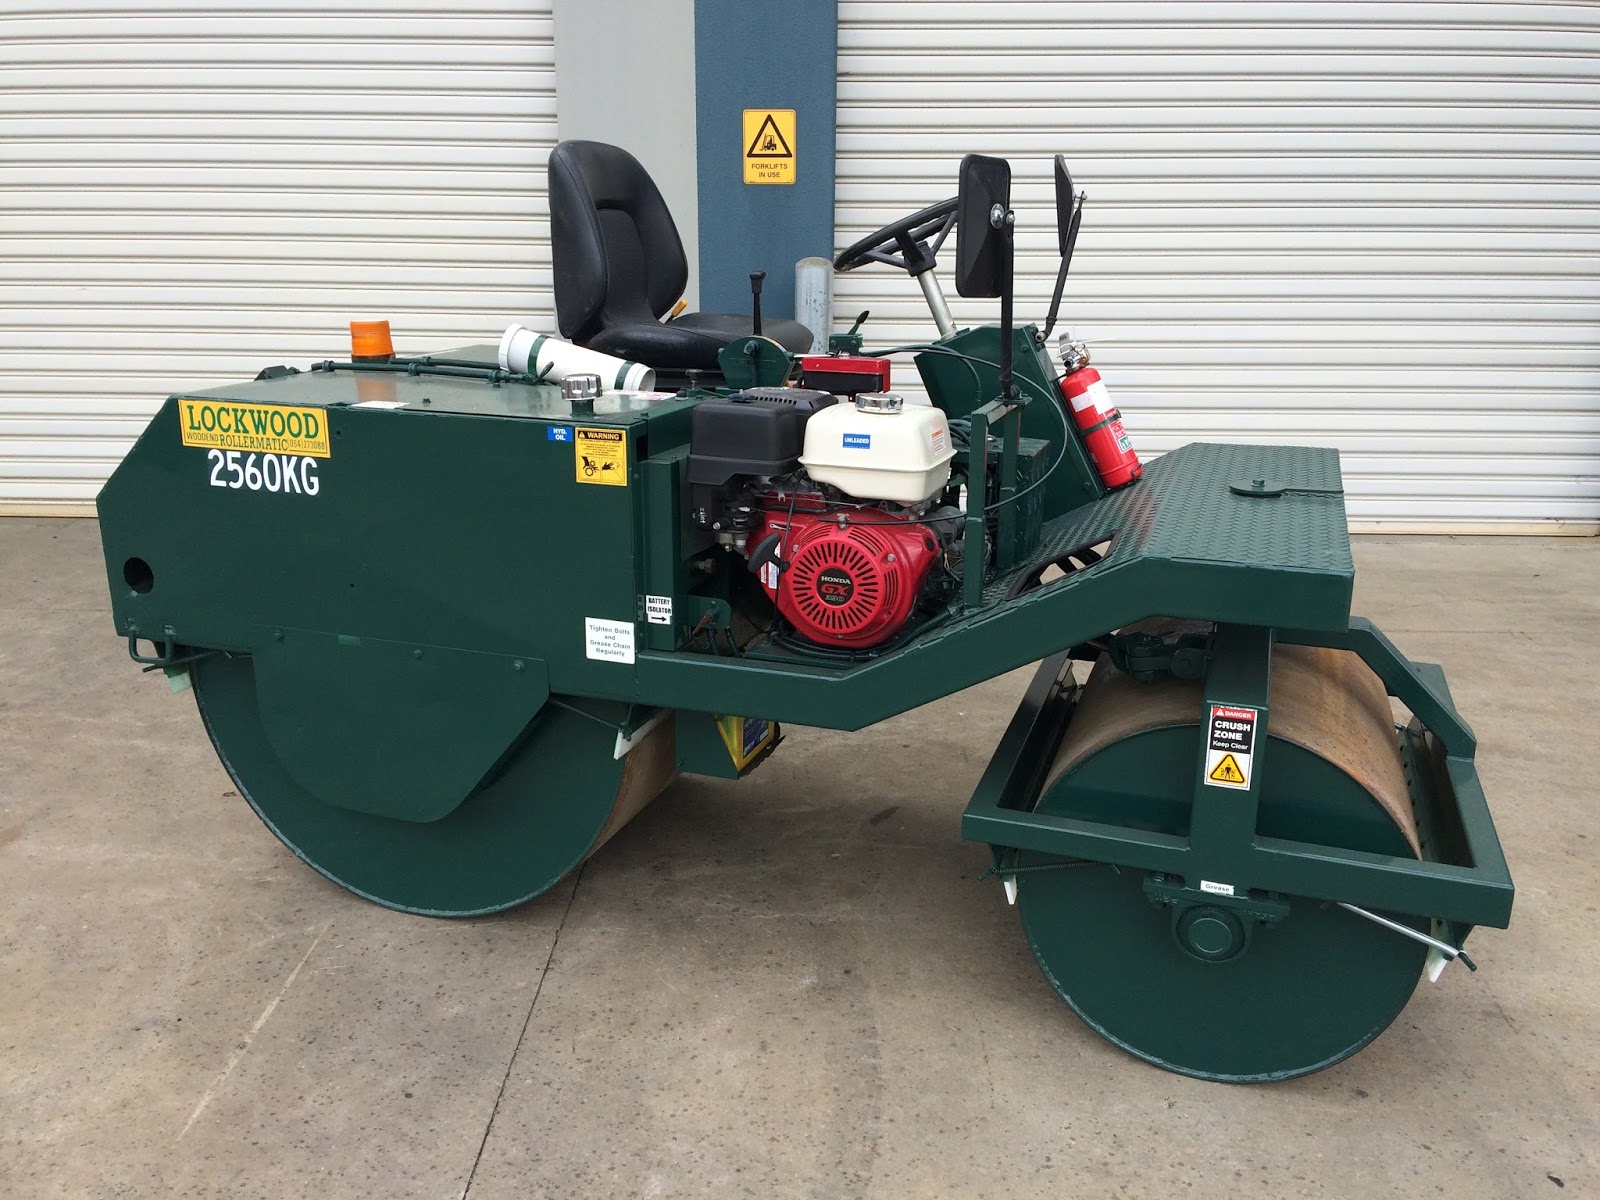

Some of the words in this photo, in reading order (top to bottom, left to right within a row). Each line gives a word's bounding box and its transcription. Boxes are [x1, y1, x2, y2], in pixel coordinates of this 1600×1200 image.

[186, 405, 319, 439] LOCKWOOD
[587, 432, 620, 440] WARNING
[219, 433, 289, 451] ROLLERMATIC
[207, 449, 320, 496] 2560KG
[820, 576, 851, 585] HONDA
[821, 584, 849, 596] GX
[648, 597, 670, 606] BATTERY
[589, 625, 612, 633] Tighten
[596, 648, 625, 657] Regularly
[1215, 720, 1251, 732] CRUSH
[1214, 730, 1243, 741] ZONE
[1206, 884, 1229, 892] Grease
